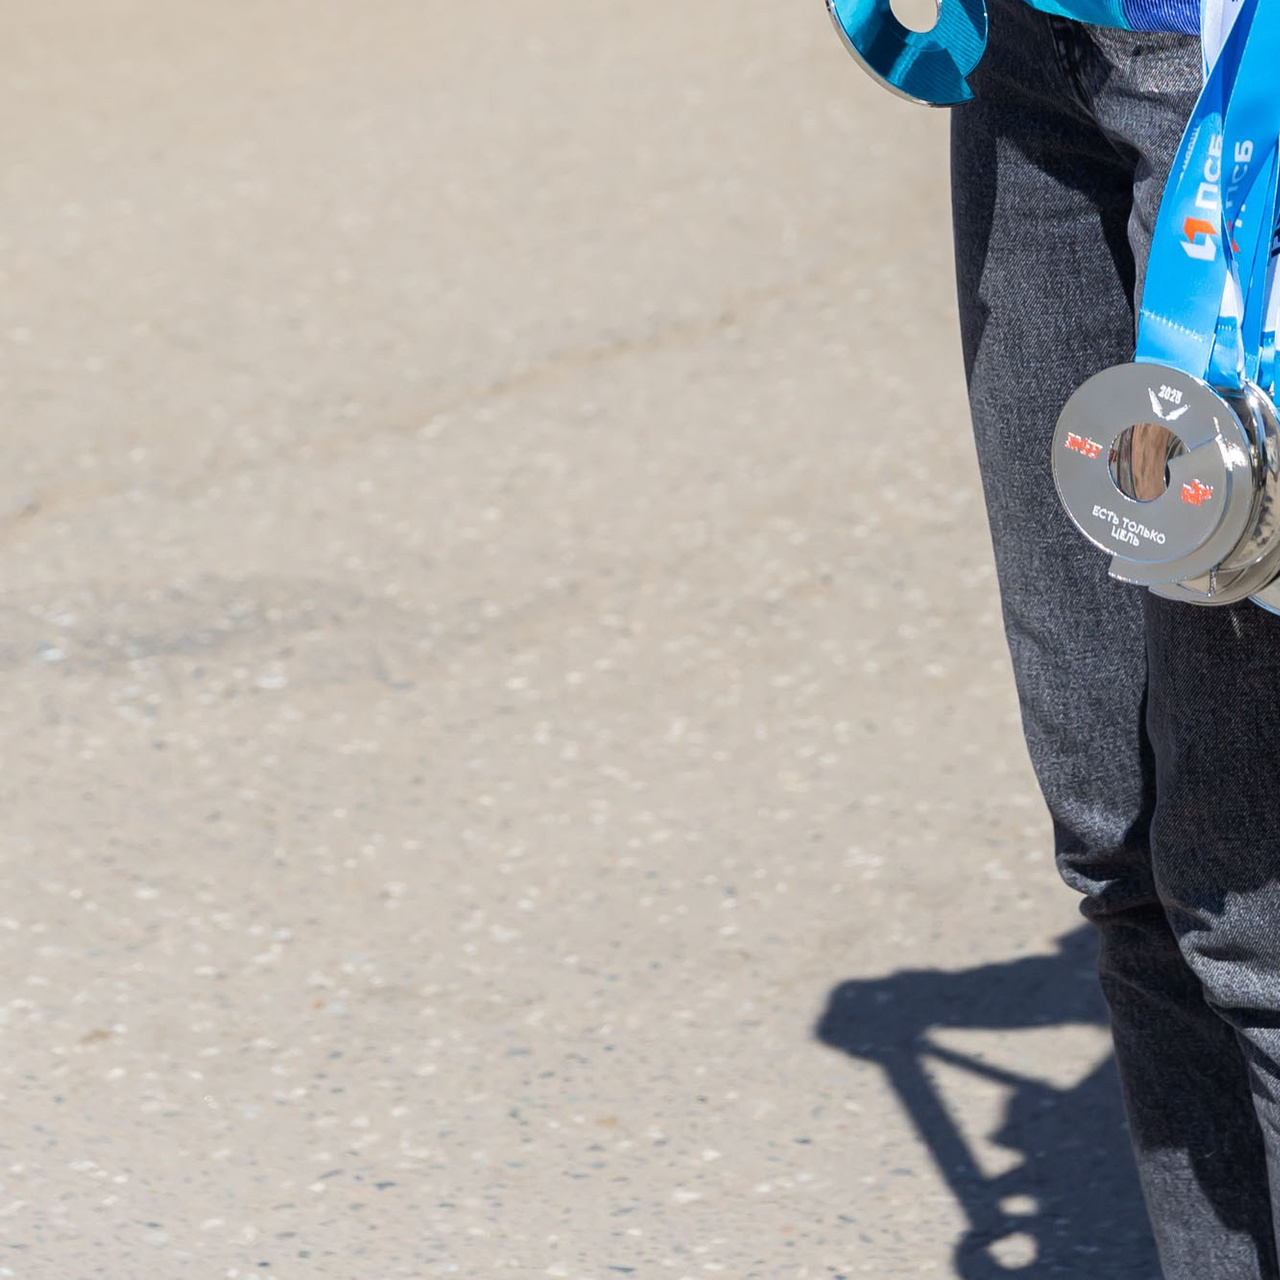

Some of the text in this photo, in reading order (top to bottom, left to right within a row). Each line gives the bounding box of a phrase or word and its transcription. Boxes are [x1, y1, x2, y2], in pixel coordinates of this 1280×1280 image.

[1195, 133, 1222, 209] ПСБ
[1092, 505, 1166, 544] ЕСТЬ ТОЛЬКО
[1111, 525, 1139, 547] ЦЕЛЬ
